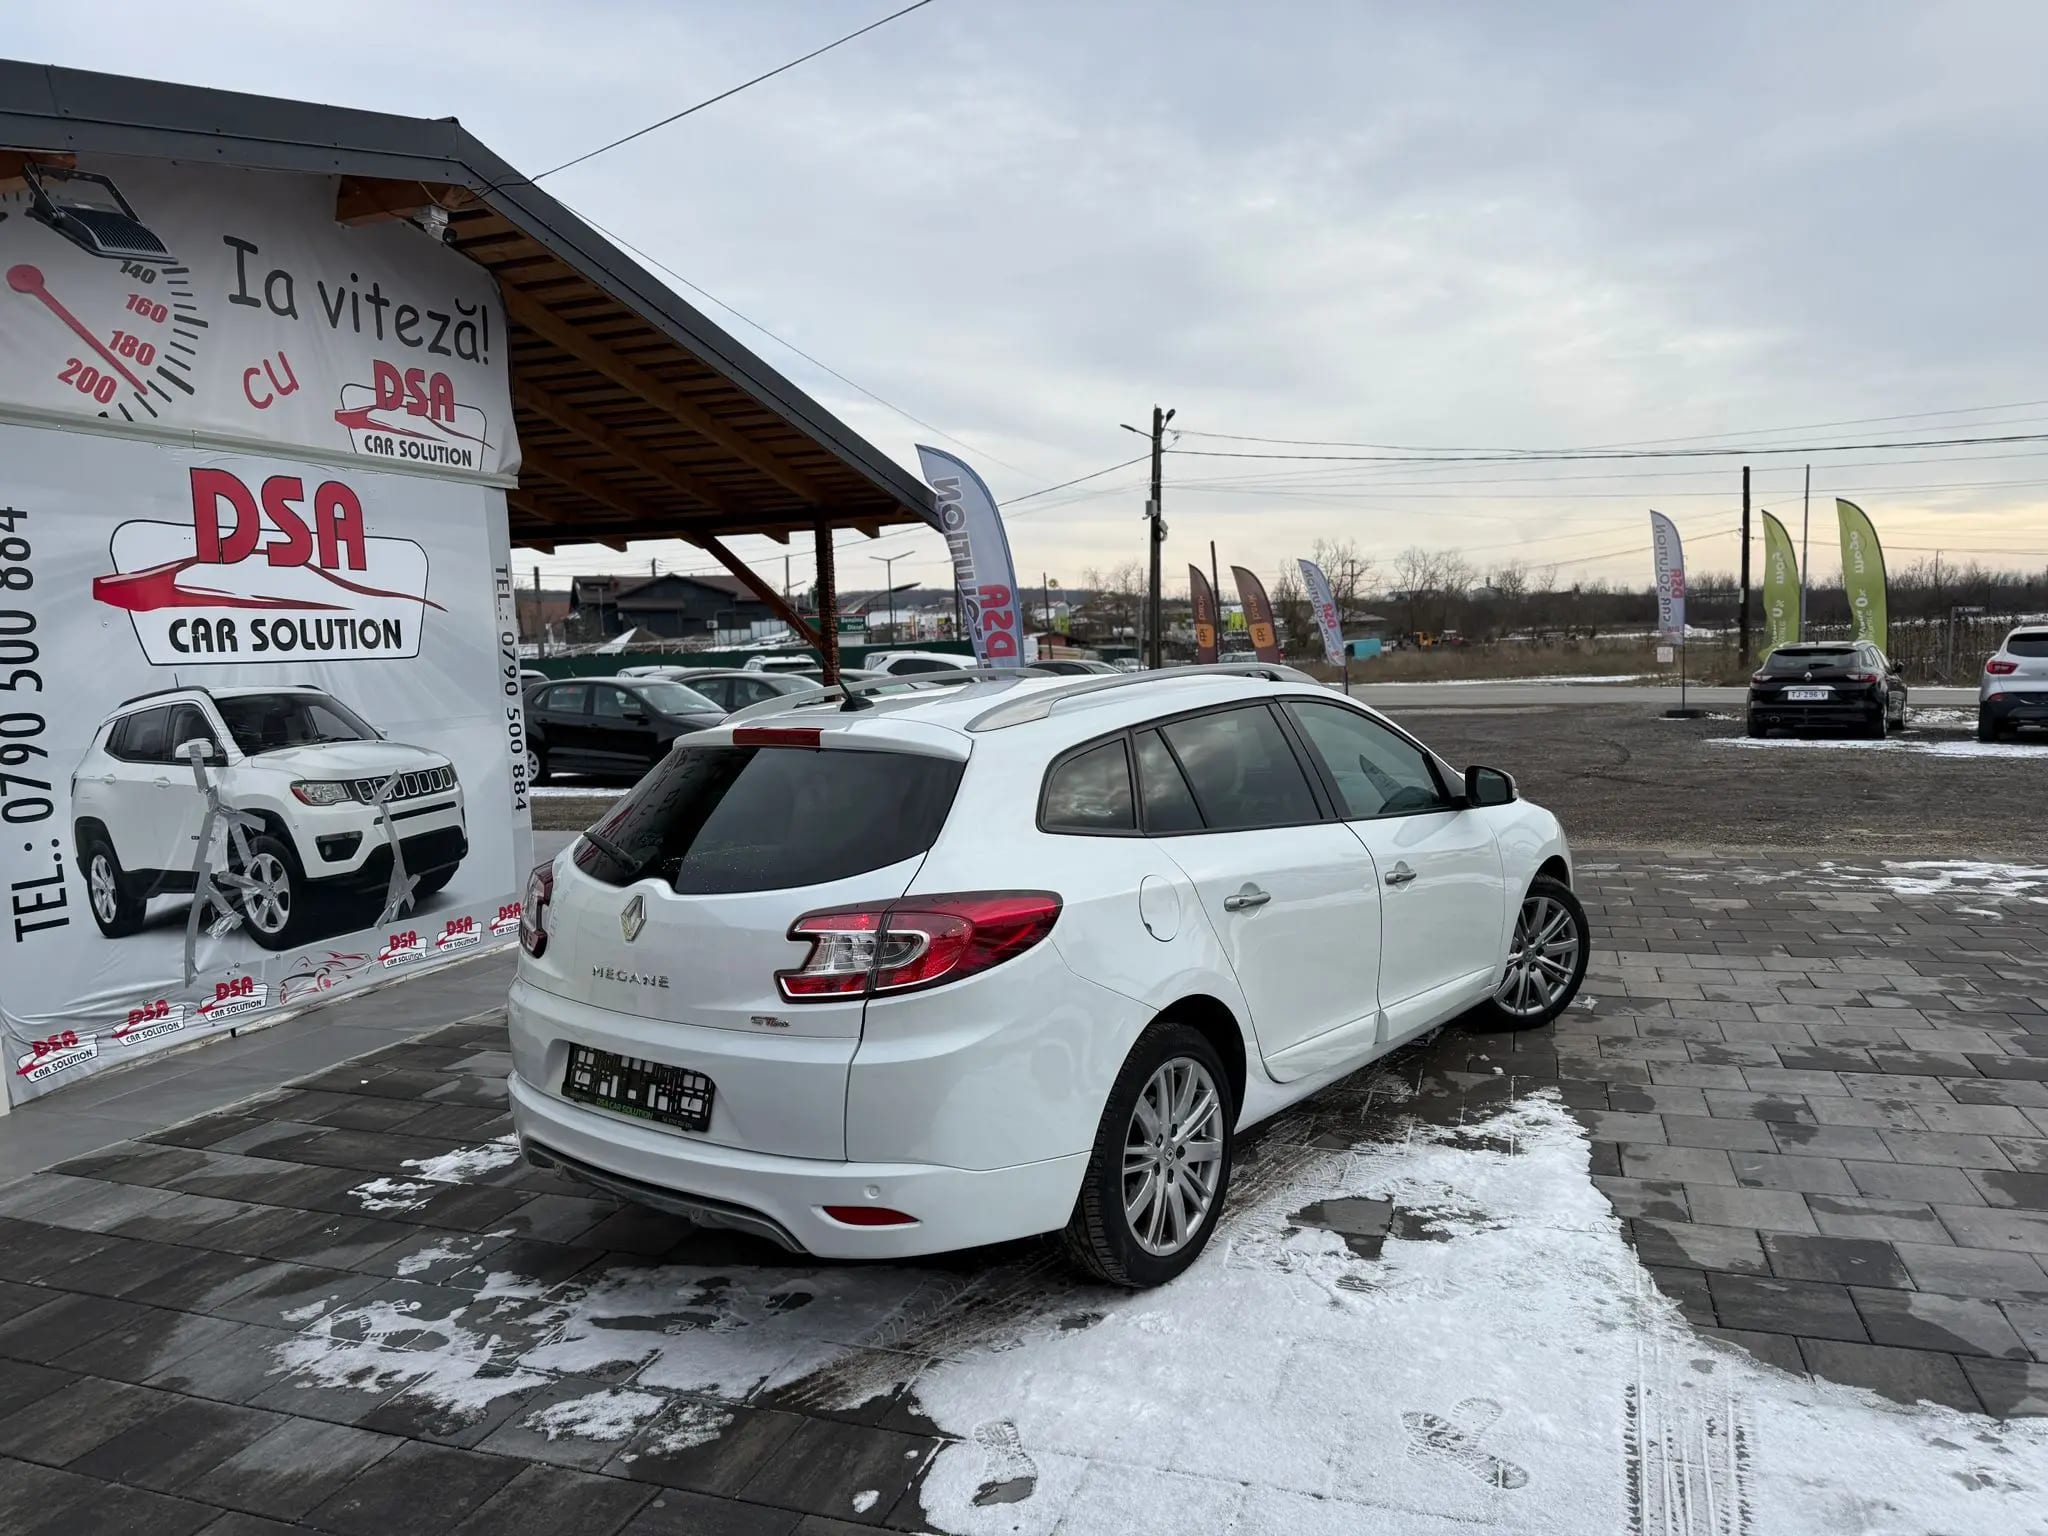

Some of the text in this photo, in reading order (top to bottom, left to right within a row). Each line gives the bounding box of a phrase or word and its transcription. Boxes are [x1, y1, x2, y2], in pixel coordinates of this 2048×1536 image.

[119, 260, 157, 285] 140
[125, 293, 169, 324] 160
[223, 235, 489, 366] Ia viteză!
[109, 330, 156, 367] 180
[57, 358, 117, 405] 200
[243, 350, 300, 410] cu
[372, 359, 457, 424] DSA
[364, 434, 473, 468] CAR SOLUTION
[189, 466, 368, 572] DSA
[0, 609, 43, 692] 500
[168, 617, 402, 653] CAR SOLUTION
[501, 631, 518, 697] 0790
[507, 707, 524, 755] 500
[0, 712, 55, 824] 0790
[512, 763, 528, 812] 884
[446, 915, 473, 935] DSA
[498, 902, 521, 920] DSA
[389, 930, 417, 951] DSA
[443, 936, 478, 950] CAR SOLUTION
[386, 952, 424, 967] CAR SOLUTION
[215, 975, 254, 1001] DSA
[127, 999, 170, 1026] DSA
[210, 999, 262, 1019] CAR SOLUTION
[31, 1029, 79, 1058] DSA
[125, 1021, 180, 1044] CAR SOLUTION
[33, 1048, 93, 1079] CAR SOLUTION
[609, 1102, 622, 1113] CAR
[622, 1105, 654, 1121] SOLUTION
